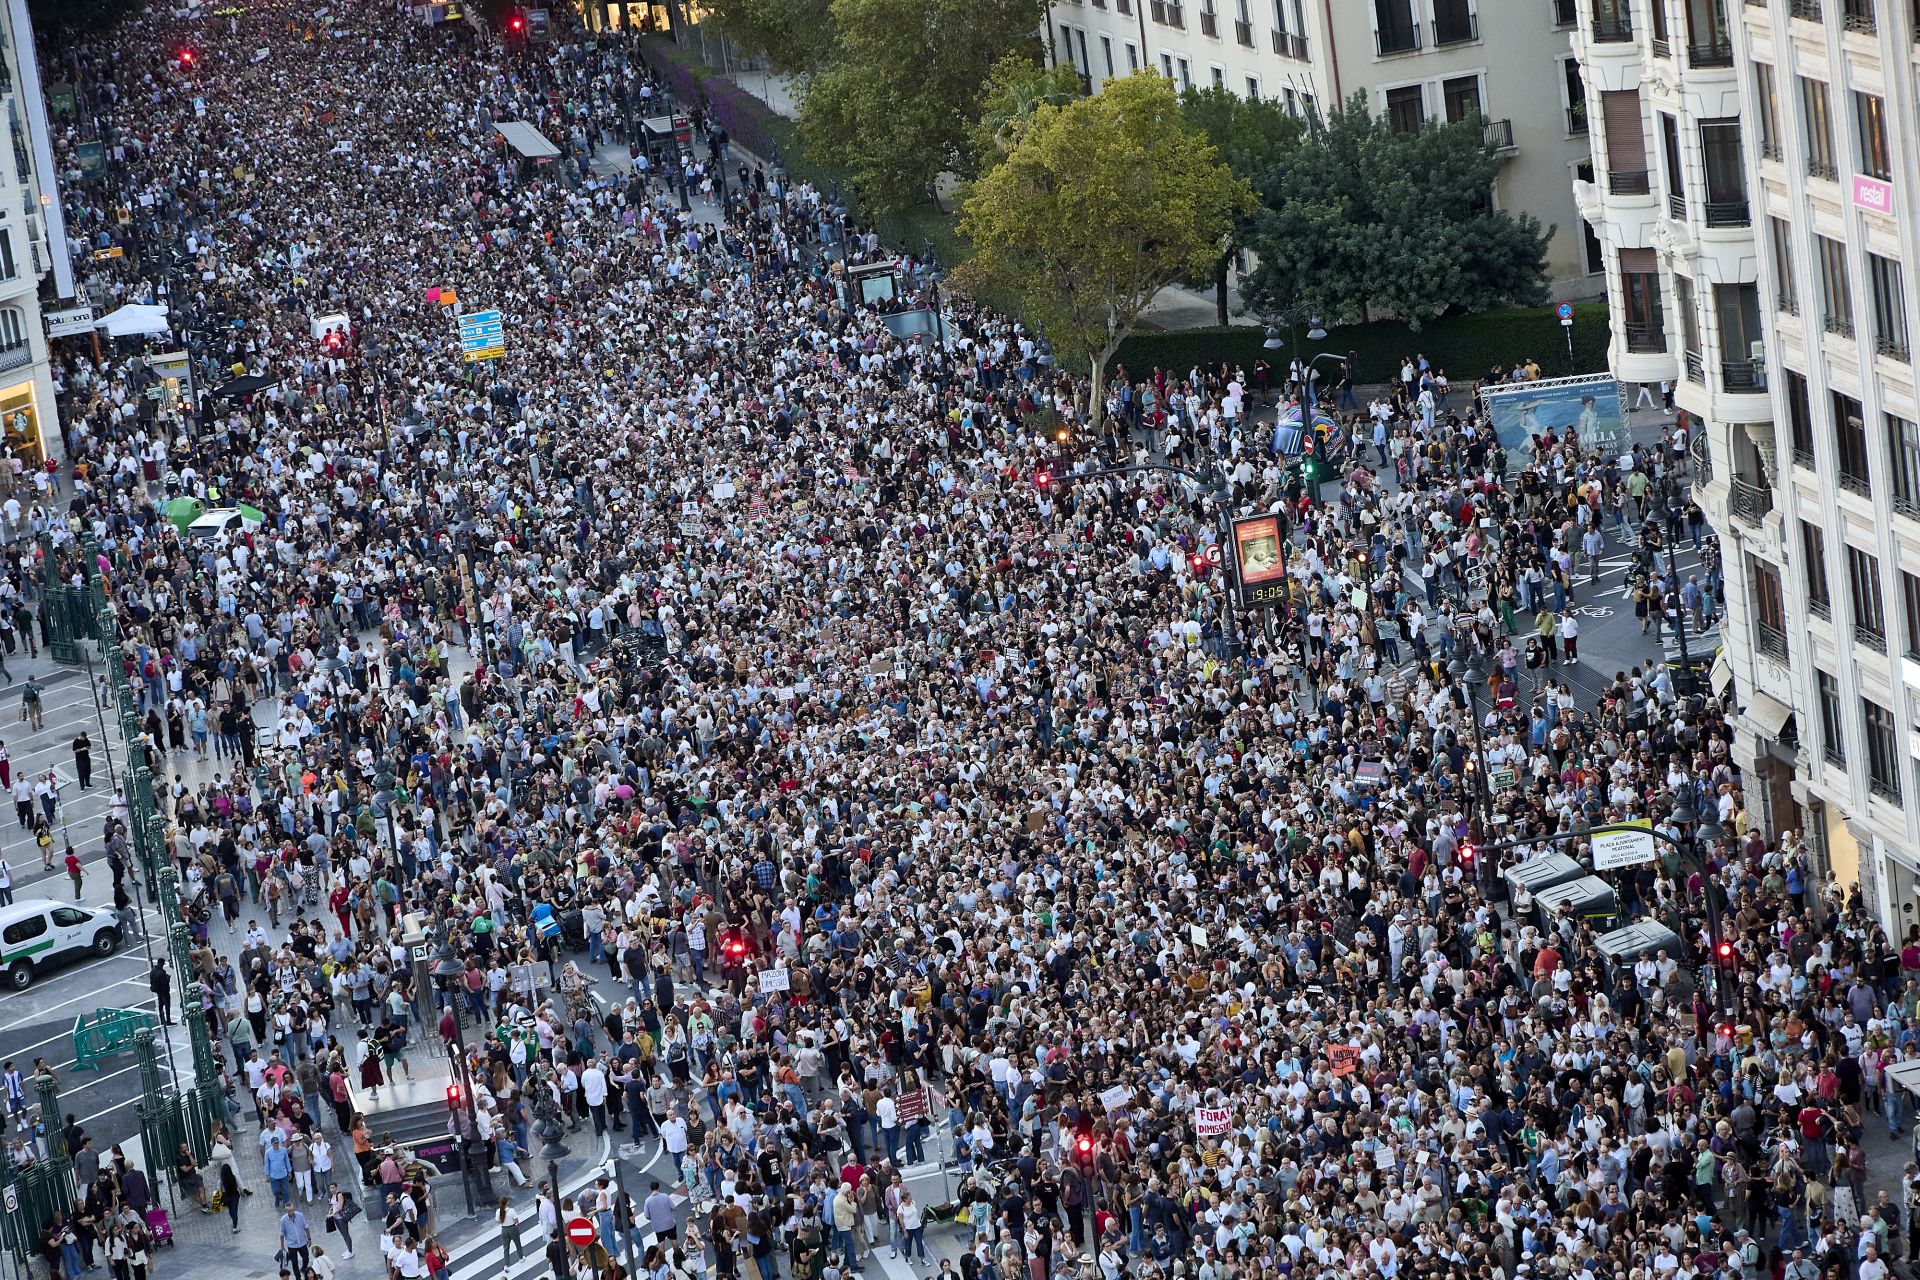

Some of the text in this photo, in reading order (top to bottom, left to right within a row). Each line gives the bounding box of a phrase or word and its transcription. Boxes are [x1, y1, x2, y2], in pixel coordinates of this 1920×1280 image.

[1860, 184, 1885, 207] restail
[1252, 585, 1283, 600] 19:05
[1611, 844, 1635, 852] PEATONAL
[1615, 836, 1646, 846] AJUNTAMENT
[1200, 1104, 1231, 1122] FORA!
